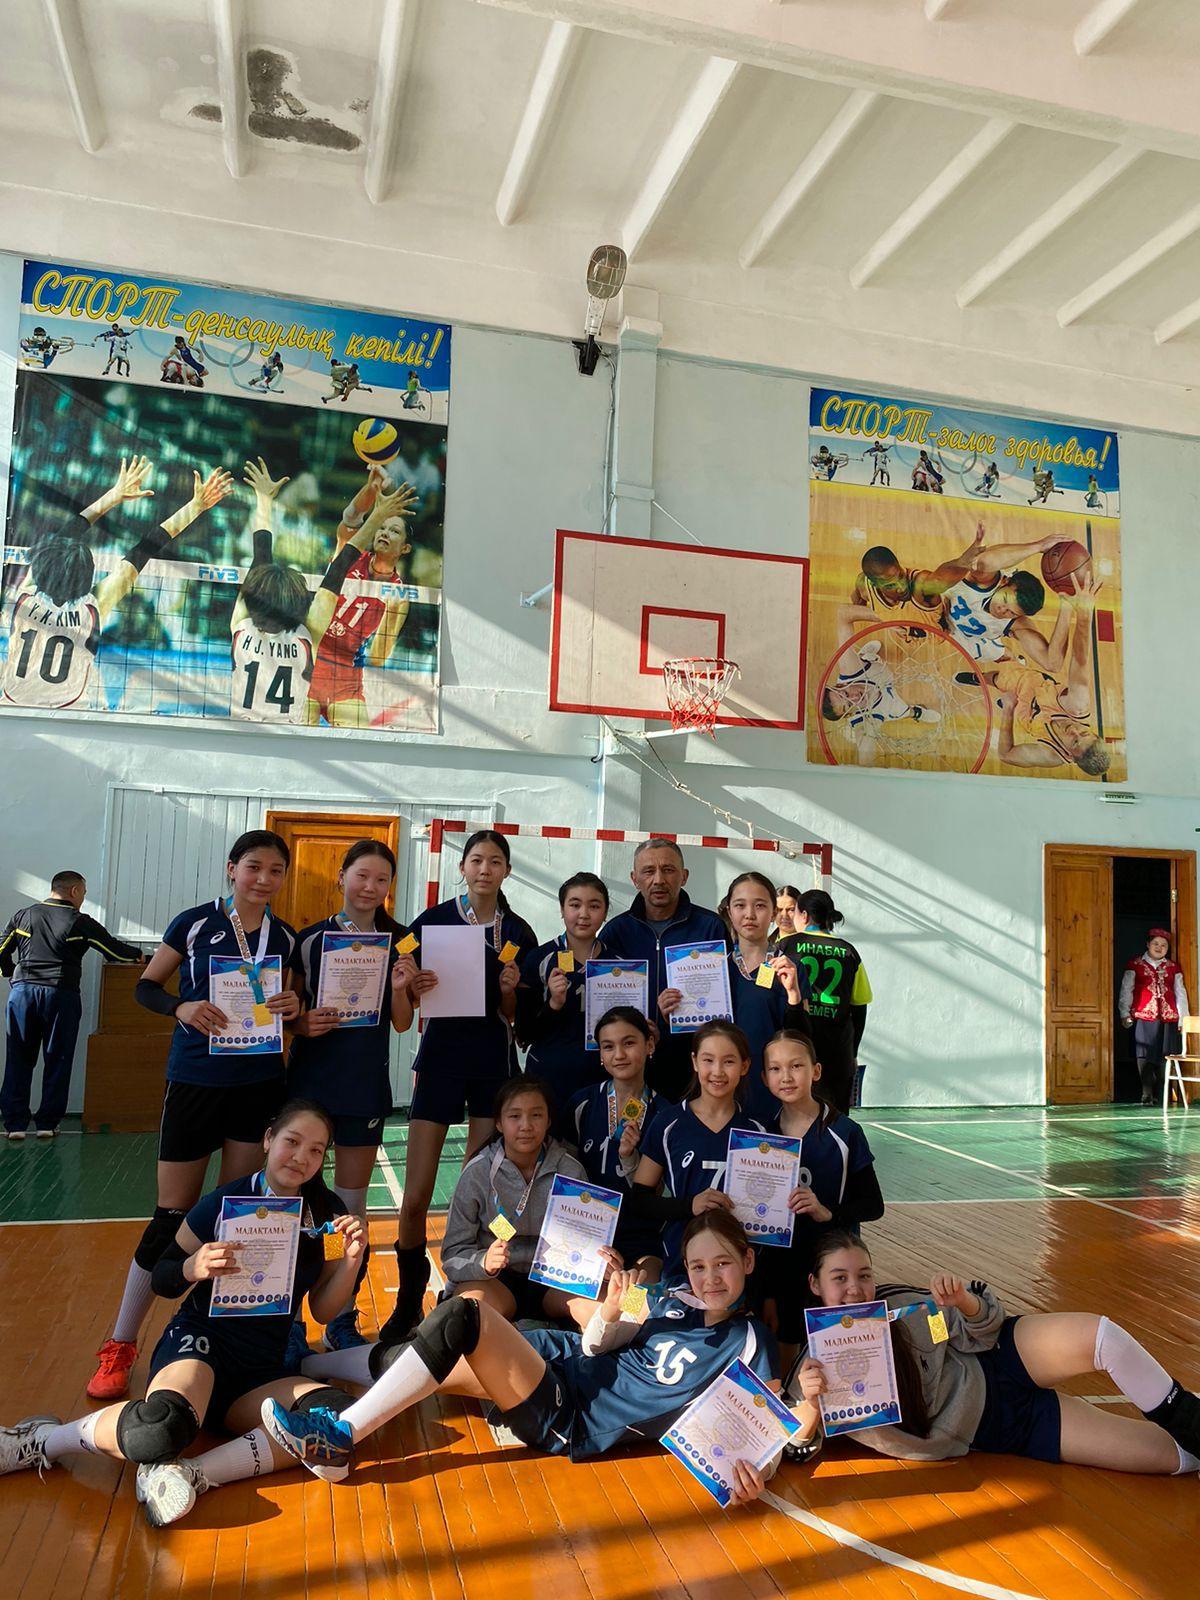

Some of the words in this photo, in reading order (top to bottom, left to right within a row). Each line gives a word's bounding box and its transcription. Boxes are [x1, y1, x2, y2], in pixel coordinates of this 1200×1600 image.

[32, 270, 337, 361] СПОРТ-денсаулық
[345, 328, 444, 369] кепілі!
[820, 395, 997, 455] СПОРТ-залог
[1004, 435, 1112, 472] здоровья!
[56, 610, 81, 627] KIM
[16, 628, 75, 684] 10
[269, 641, 298, 659] YANG
[242, 660, 295, 714] 14
[796, 942, 847, 958] ИНАБАТ
[801, 955, 842, 1005] 22
[807, 1005, 838, 1018] EMEY
[178, 1334, 210, 1355] 20
[646, 1340, 698, 1385] 15
